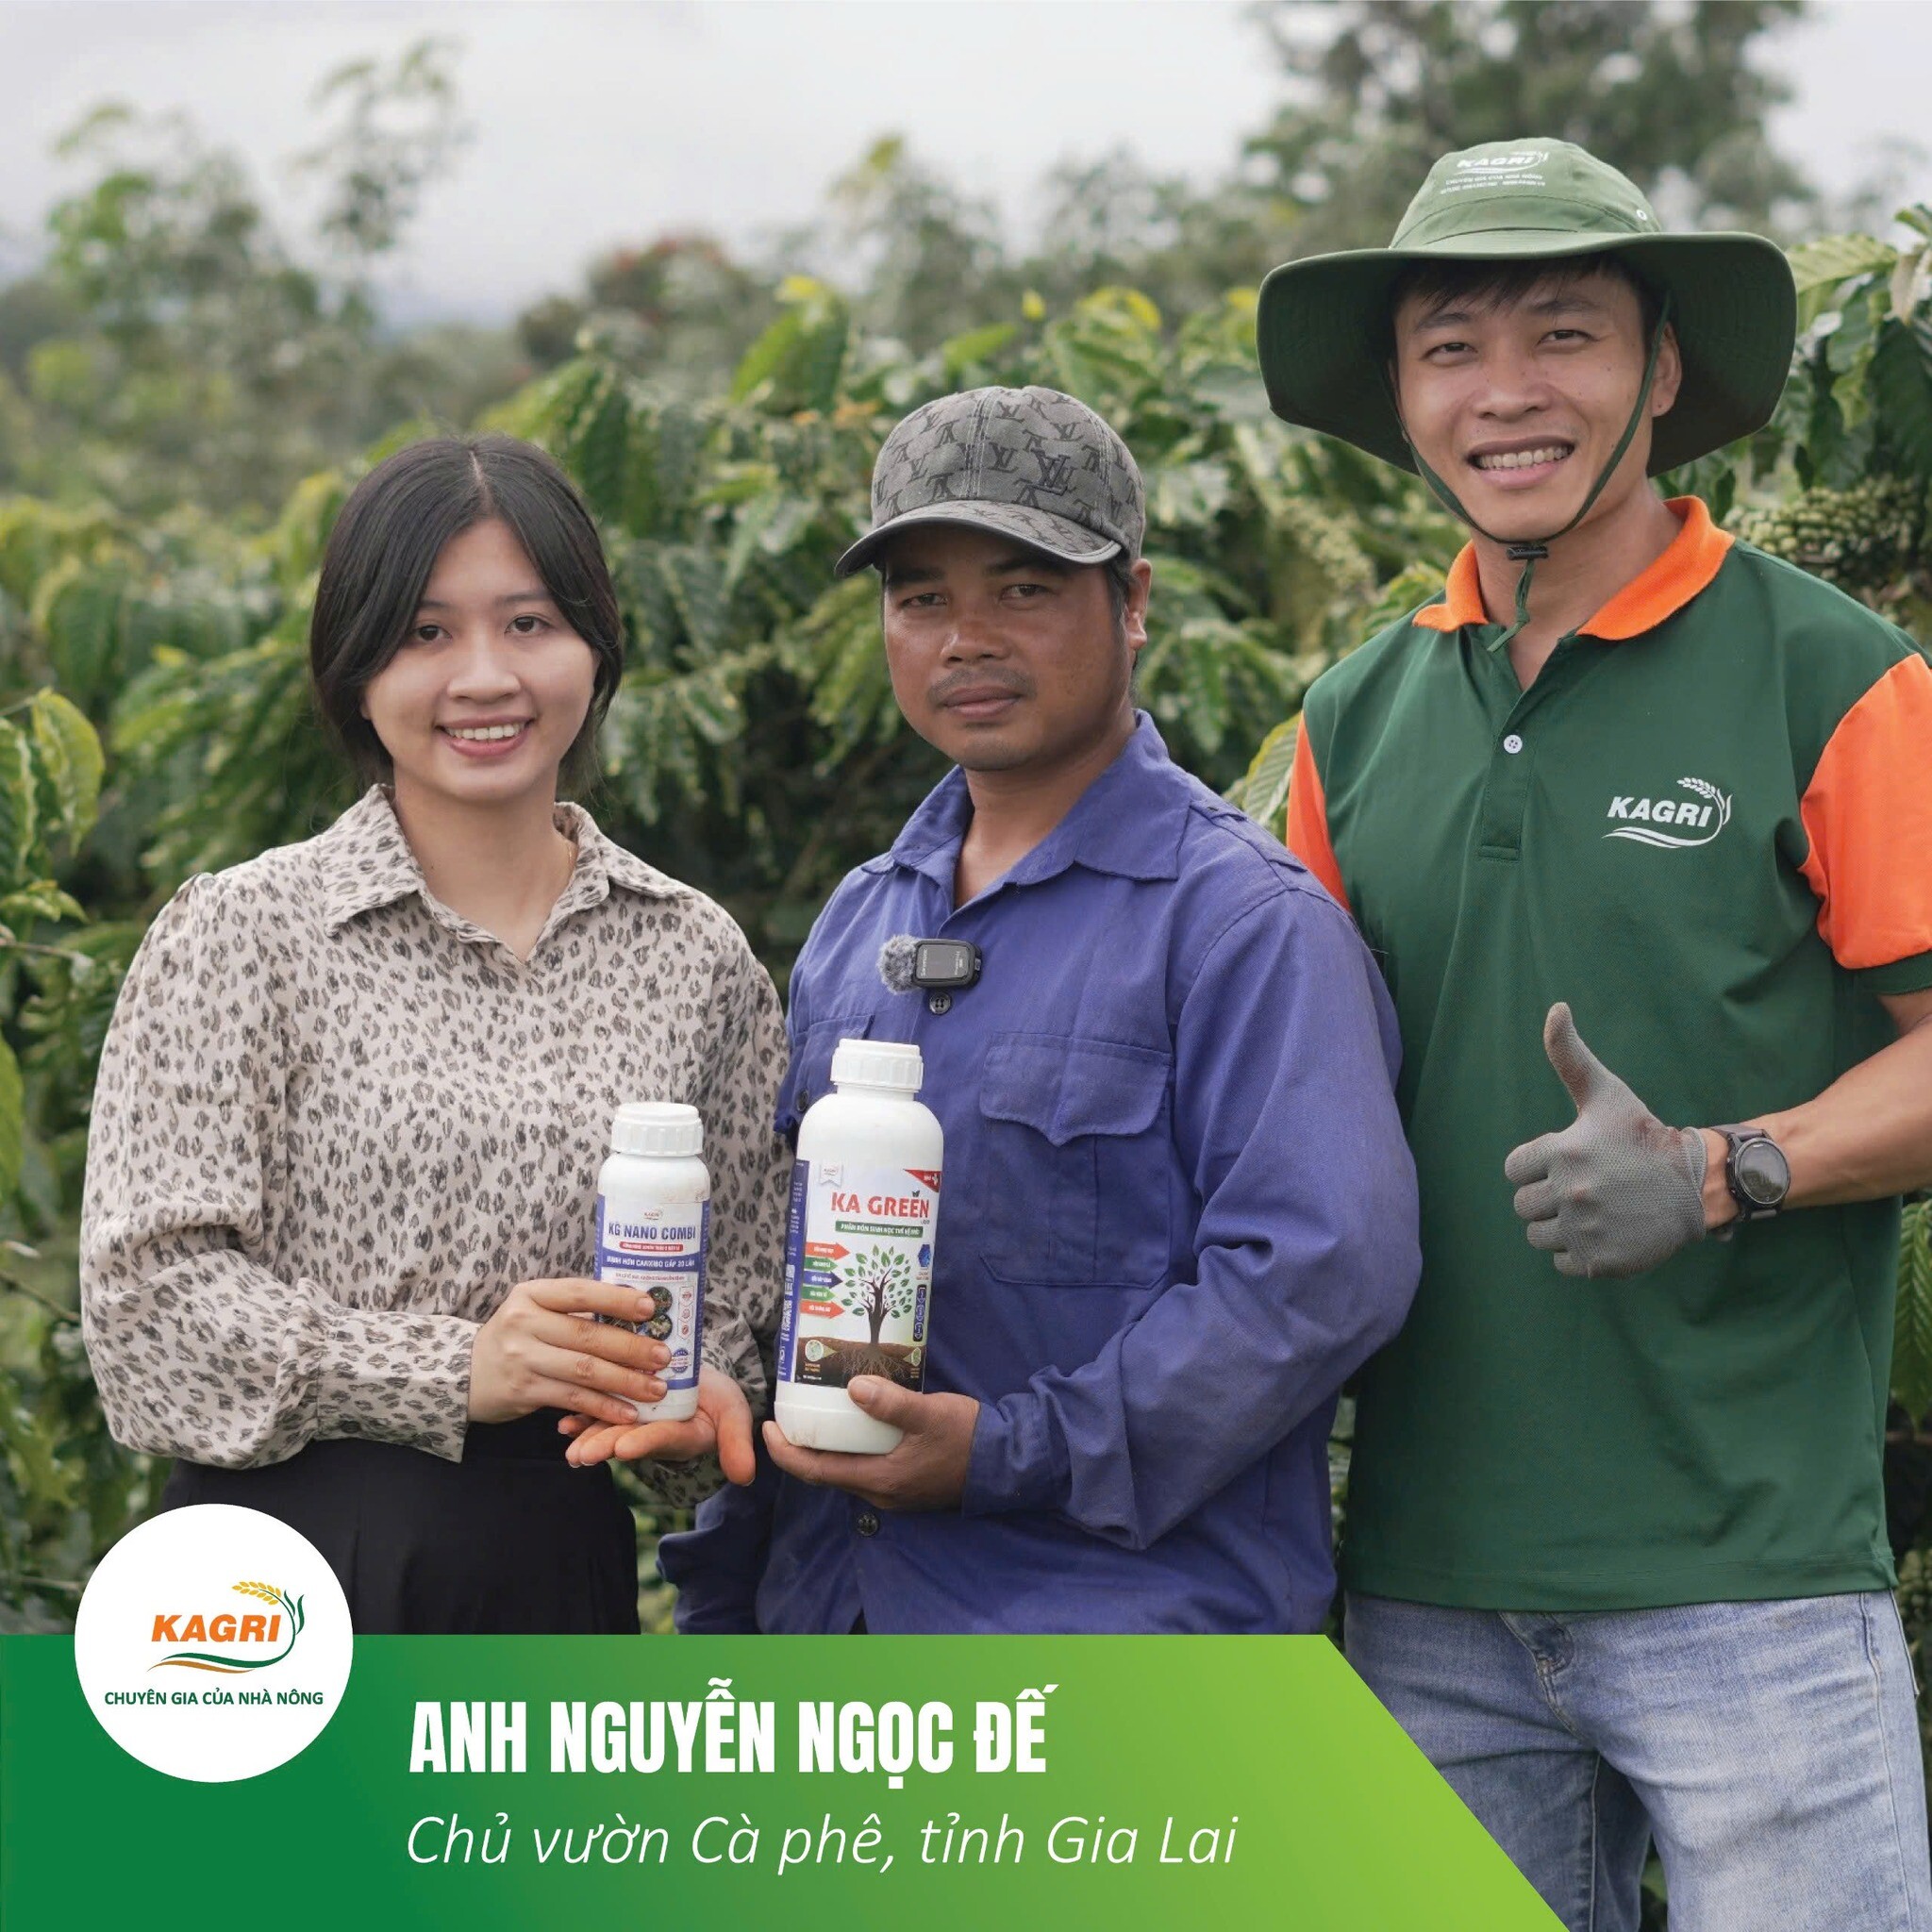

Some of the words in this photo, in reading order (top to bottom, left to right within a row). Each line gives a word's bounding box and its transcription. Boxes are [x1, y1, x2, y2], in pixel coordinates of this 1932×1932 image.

[1607, 796, 1713, 827] KAGRI
[831, 1191, 860, 1213] KA
[868, 1195, 929, 1218] GREEN
[608, 1223, 621, 1236] KG
[624, 1225, 658, 1240] NANO
[661, 1226, 695, 1241] COMBI
